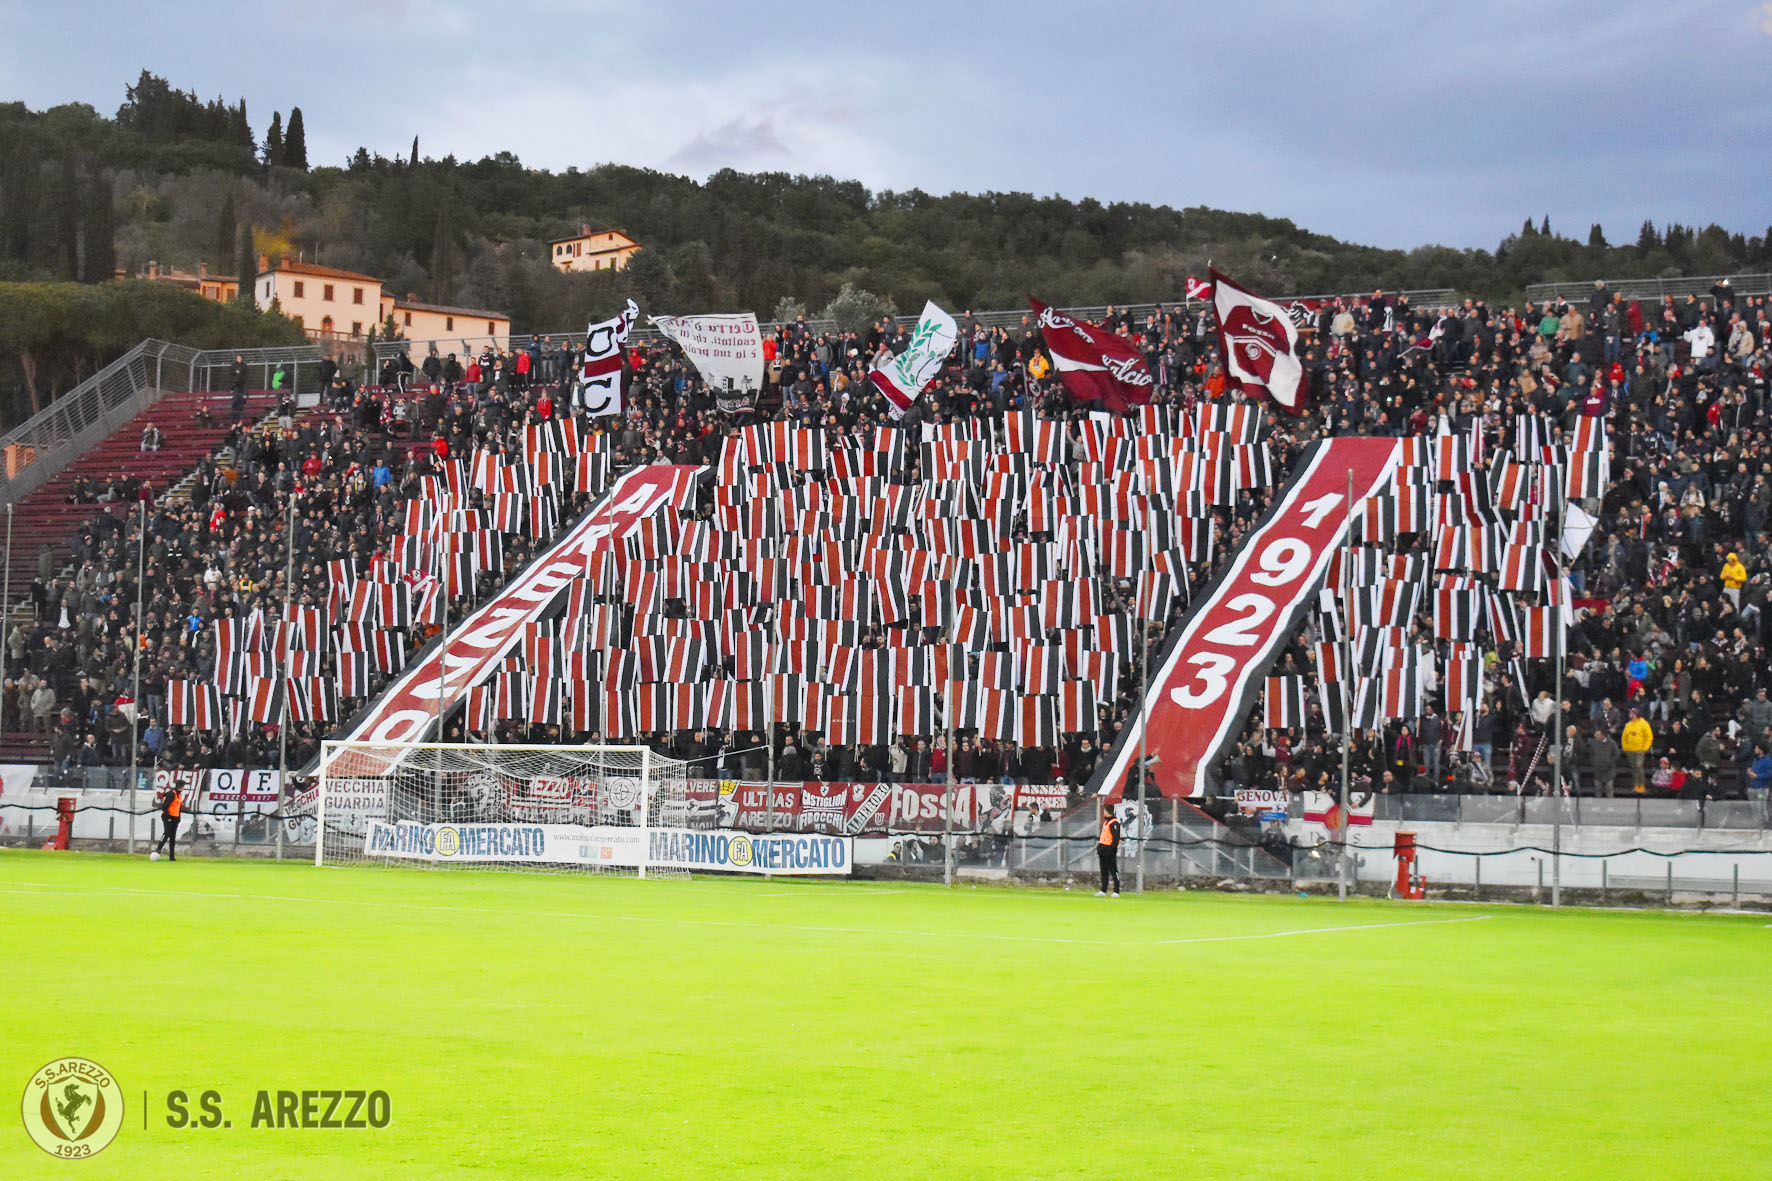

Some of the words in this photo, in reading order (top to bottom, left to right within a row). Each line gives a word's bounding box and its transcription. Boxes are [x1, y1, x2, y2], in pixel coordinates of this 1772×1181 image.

[377, 483, 658, 742] AREZZO
[1170, 492, 1344, 709] 1923
[324, 796, 385, 809] GUARDIA
[325, 780, 385, 794] VECCHIA
[1238, 791, 1287, 802] GENOVA
[889, 783, 972, 829] FOSSA
[371, 823, 435, 855] MARINO
[458, 827, 545, 857] MERCATO
[648, 832, 729, 865] MARINO
[751, 838, 845, 869] MERCATO
